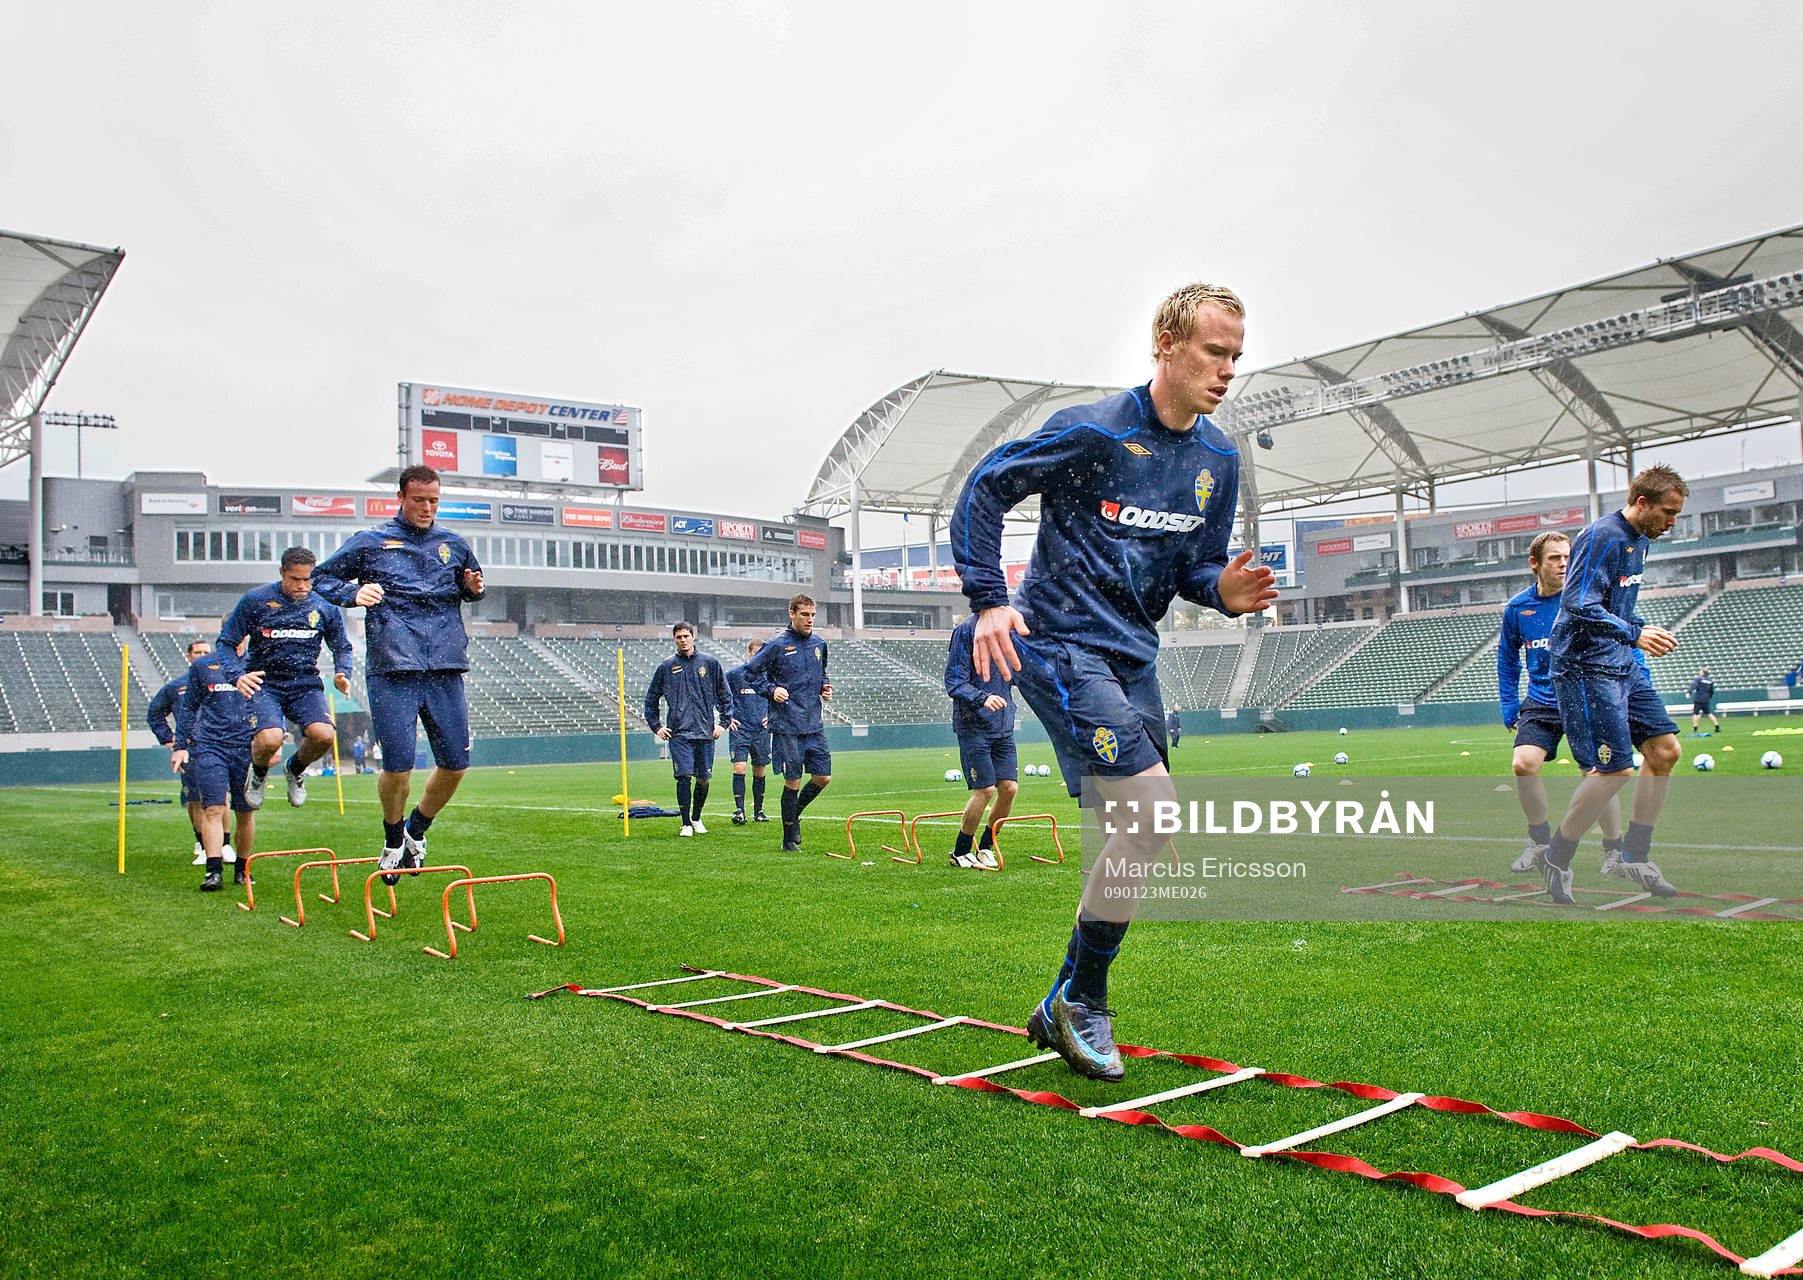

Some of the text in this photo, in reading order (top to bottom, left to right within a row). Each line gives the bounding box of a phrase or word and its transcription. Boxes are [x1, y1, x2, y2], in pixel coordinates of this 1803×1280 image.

[442, 393, 611, 421] HOME DEPOT CENTER
[425, 449, 454, 459] TOYOTA
[599, 458, 628, 471] Bud
[674, 520, 687, 529] ADT
[1119, 506, 1205, 533] ODDSET
[721, 522, 754, 534] SPORTS
[1455, 521, 1493, 532] SPORTS
[270, 629, 320, 639] ODDSET
